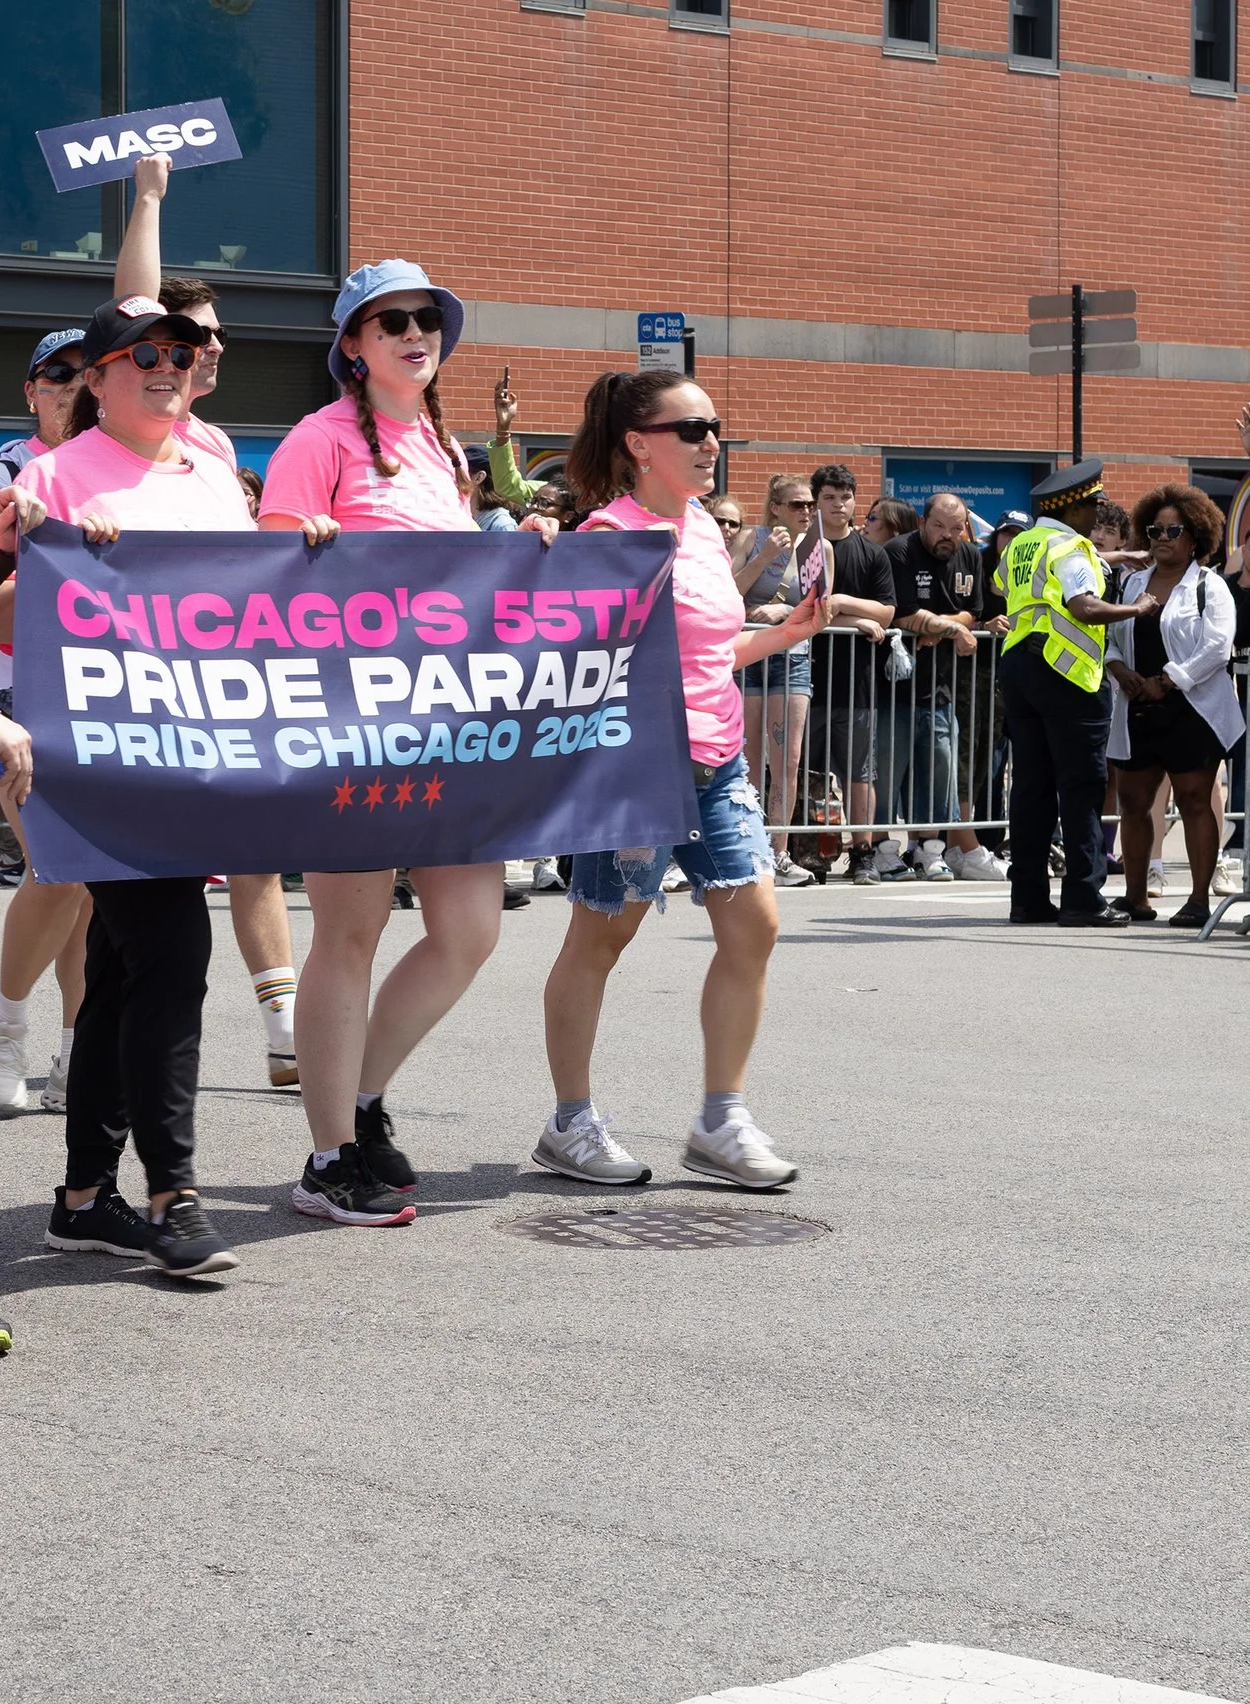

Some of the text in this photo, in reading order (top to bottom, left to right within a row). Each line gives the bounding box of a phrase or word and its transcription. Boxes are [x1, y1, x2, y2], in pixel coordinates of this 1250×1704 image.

[63, 118, 217, 169] MASC
[667, 317, 680, 326] bus
[667, 328, 684, 340] stop
[899, 484, 912, 493] Scan
[920, 484, 931, 493] visit
[56, 578, 656, 650] CHICAGO'S 55TH
[61, 643, 637, 719] PRIDE PARADE
[70, 705, 632, 769] PRIDE CHICAGO 2026
